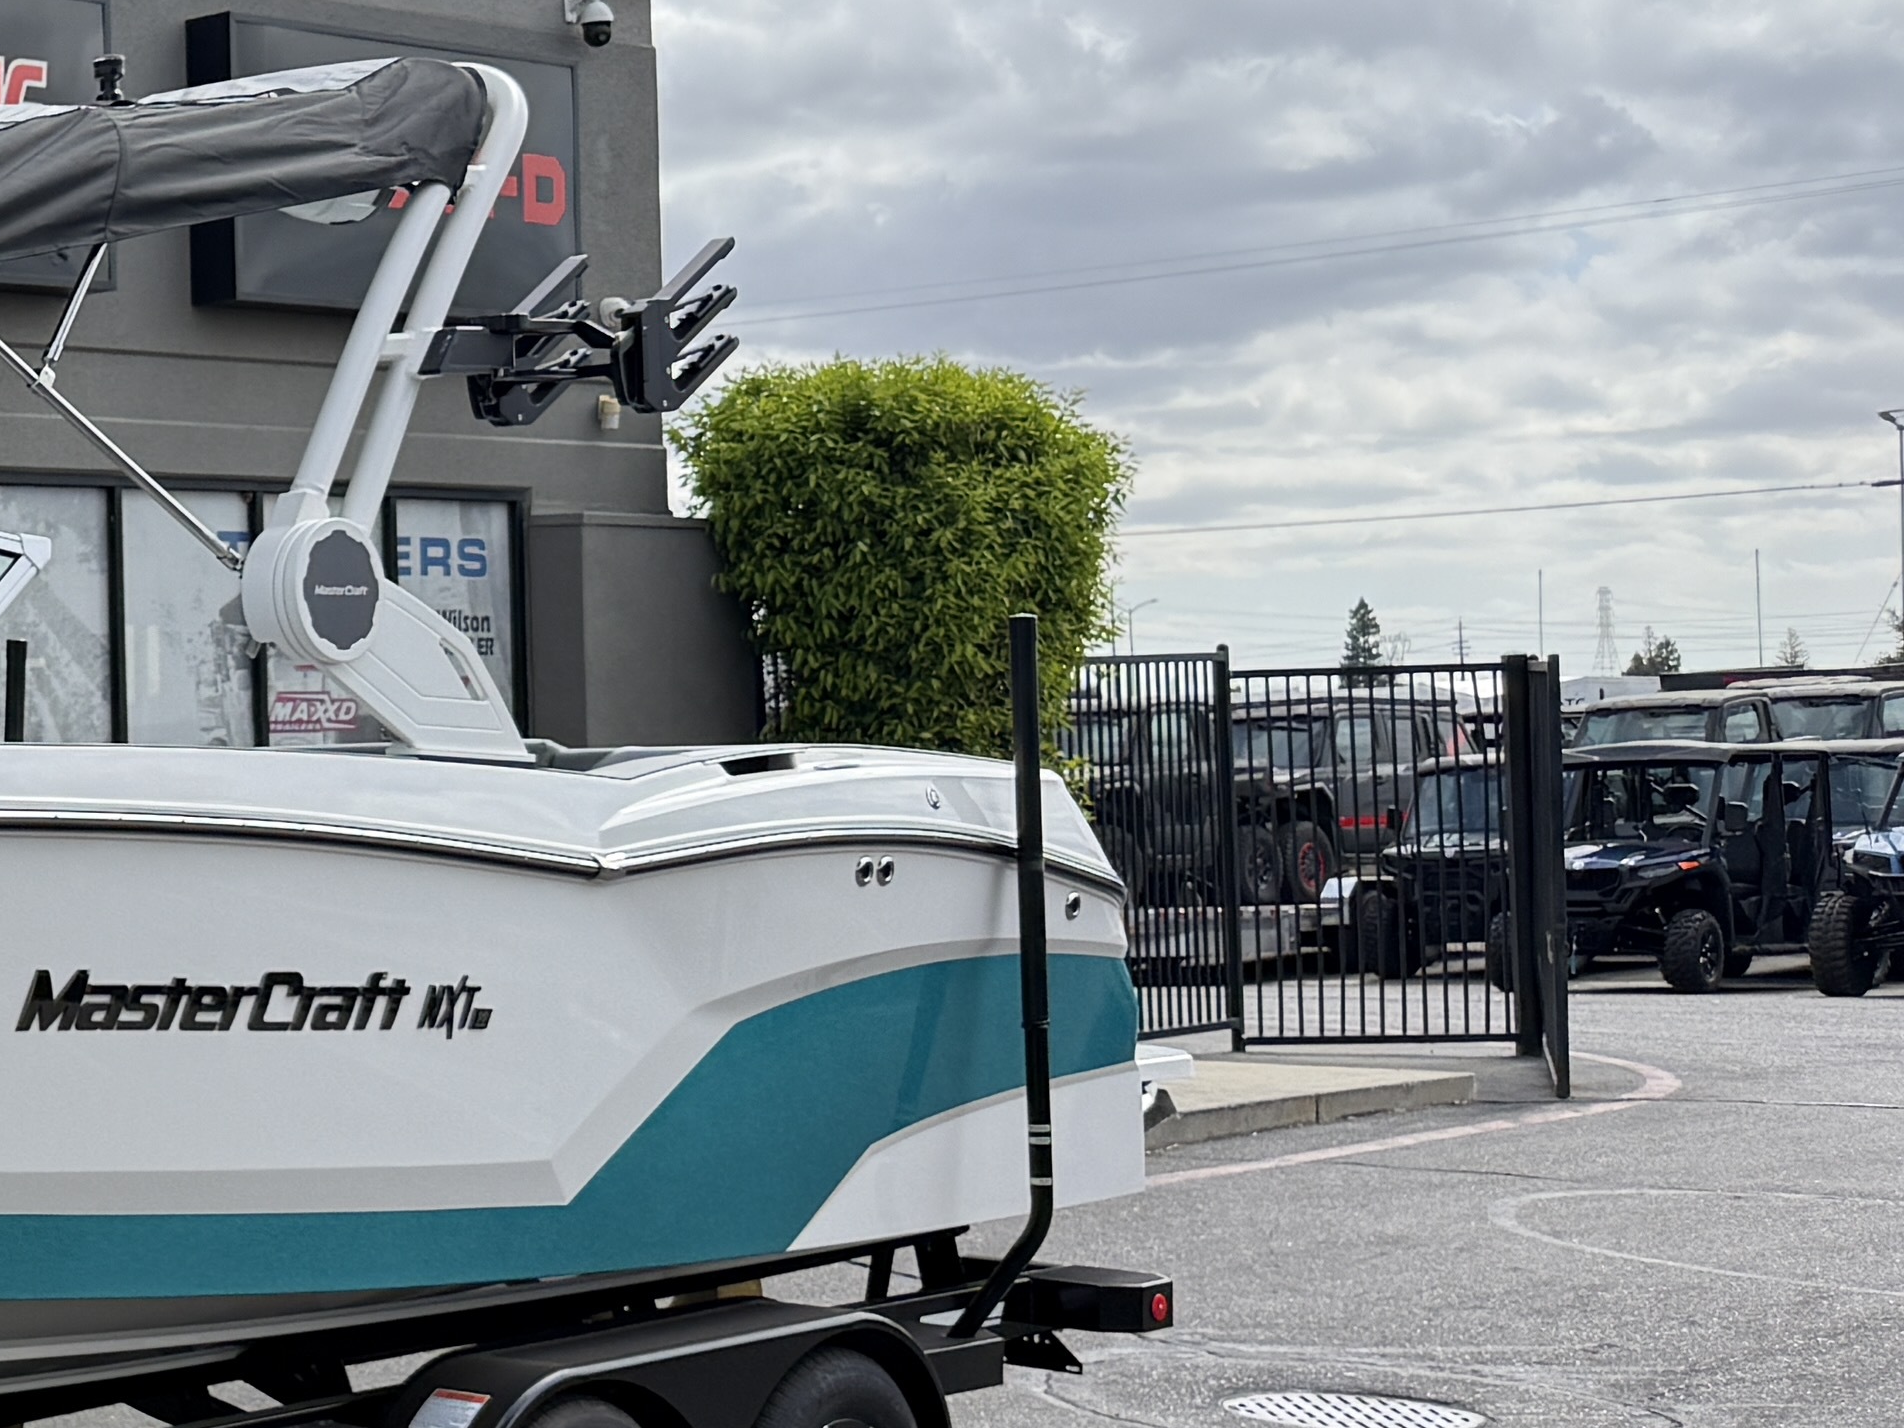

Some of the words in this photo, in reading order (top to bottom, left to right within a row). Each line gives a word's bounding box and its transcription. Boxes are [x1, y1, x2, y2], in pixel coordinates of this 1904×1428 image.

[271, 700, 356, 721] MAXXD
[15, 969, 411, 1032] MasterCraft
[416, 974, 482, 1040] NXT
